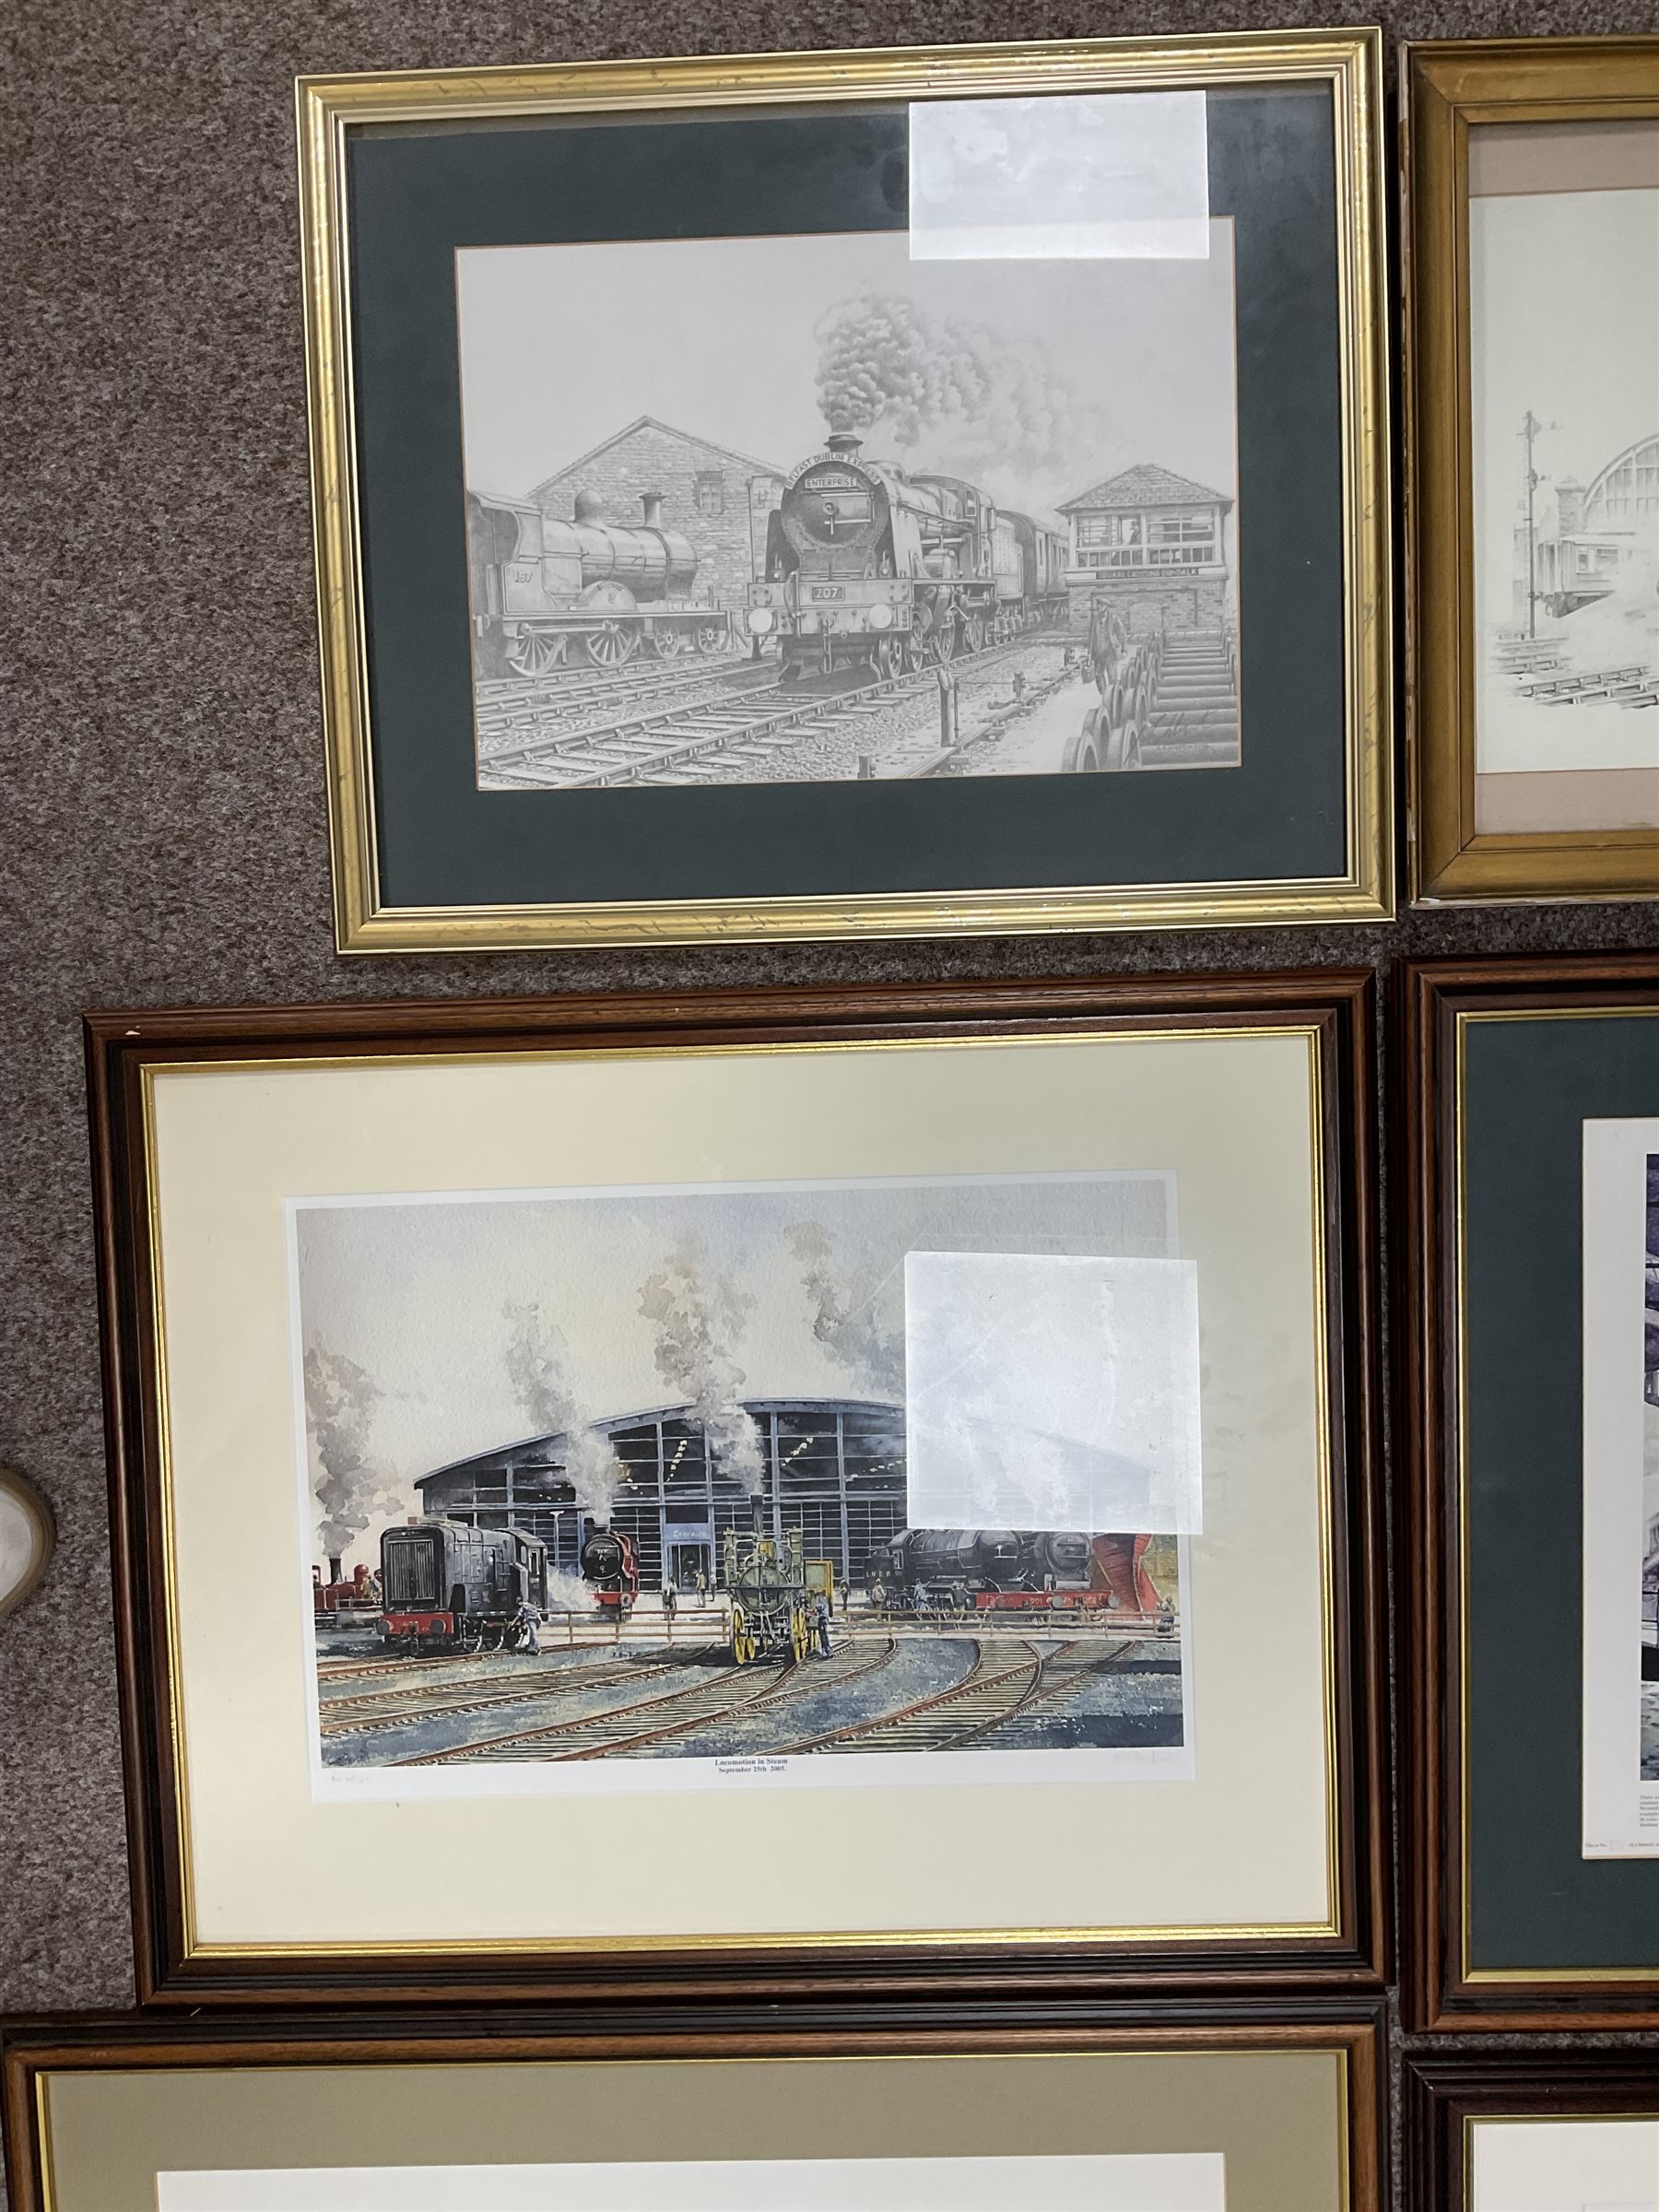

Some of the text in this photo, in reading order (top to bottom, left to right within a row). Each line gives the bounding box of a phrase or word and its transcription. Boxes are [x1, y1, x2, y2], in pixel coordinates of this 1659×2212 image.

[814, 453, 844, 463] DUBLIN
[806, 477, 856, 487] ENTERPRISE
[816, 587, 838, 599] 207
